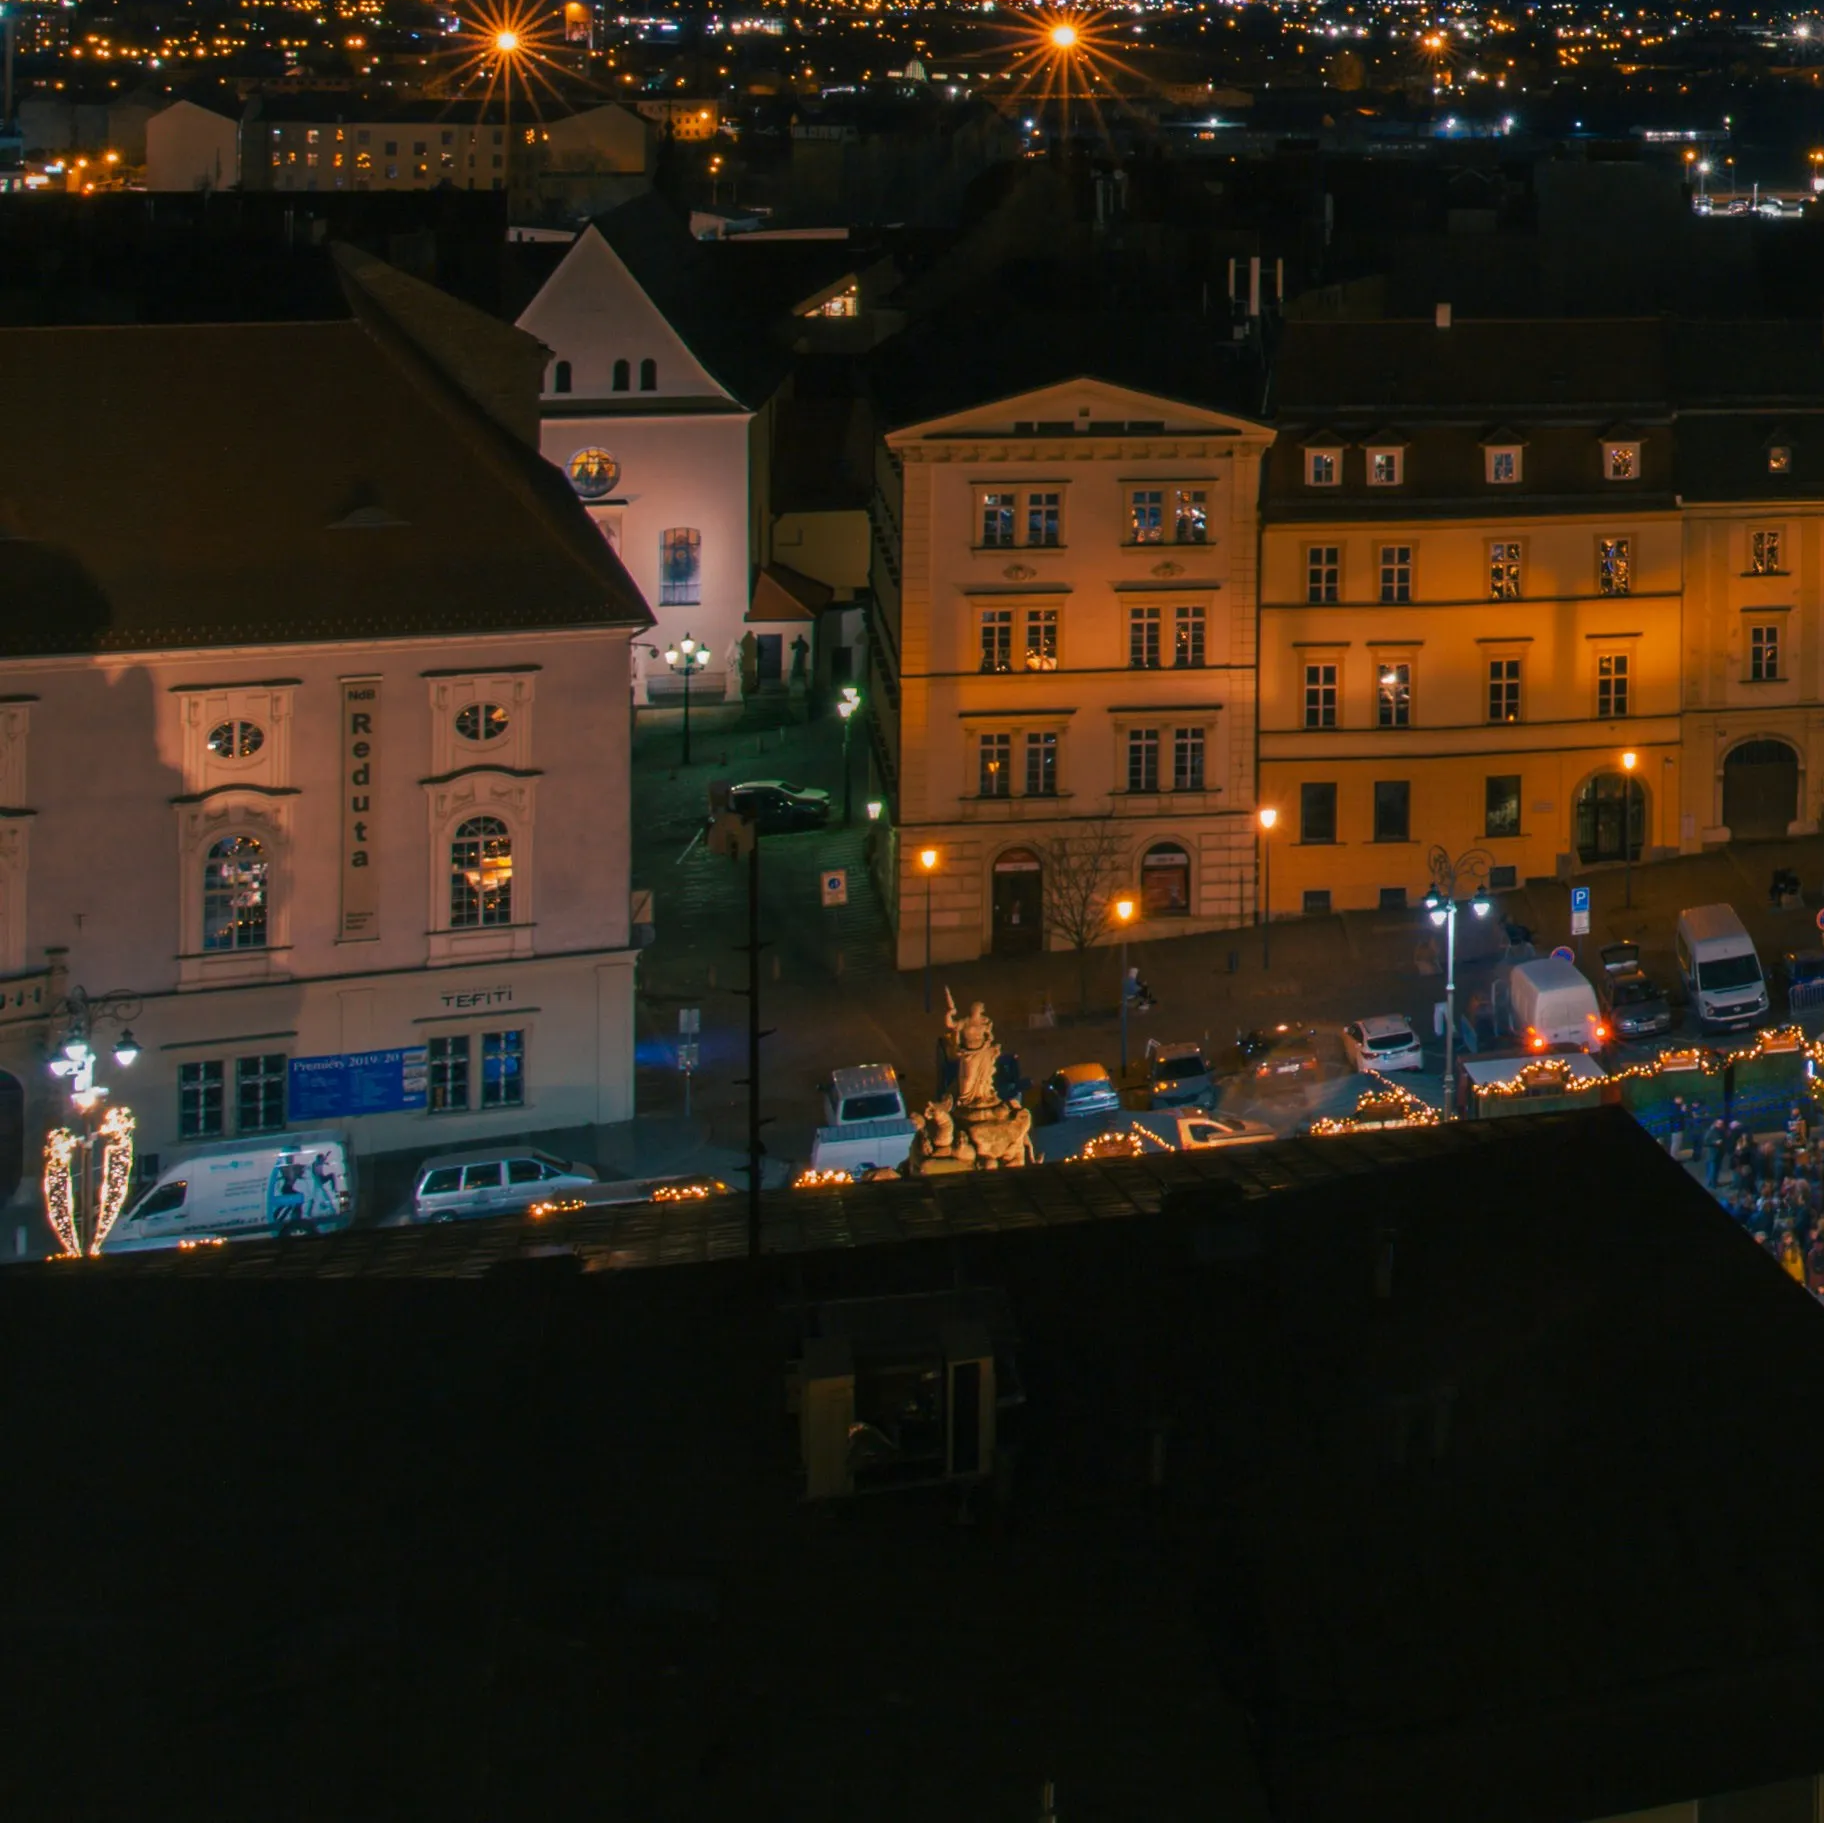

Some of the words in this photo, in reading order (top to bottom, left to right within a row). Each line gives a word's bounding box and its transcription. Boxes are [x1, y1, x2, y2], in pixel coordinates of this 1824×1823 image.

[348, 689, 376, 701] NdB
[352, 712, 372, 868] Reduta
[1576, 891, 1586, 905] P
[441, 991, 512, 1008] TEFITI
